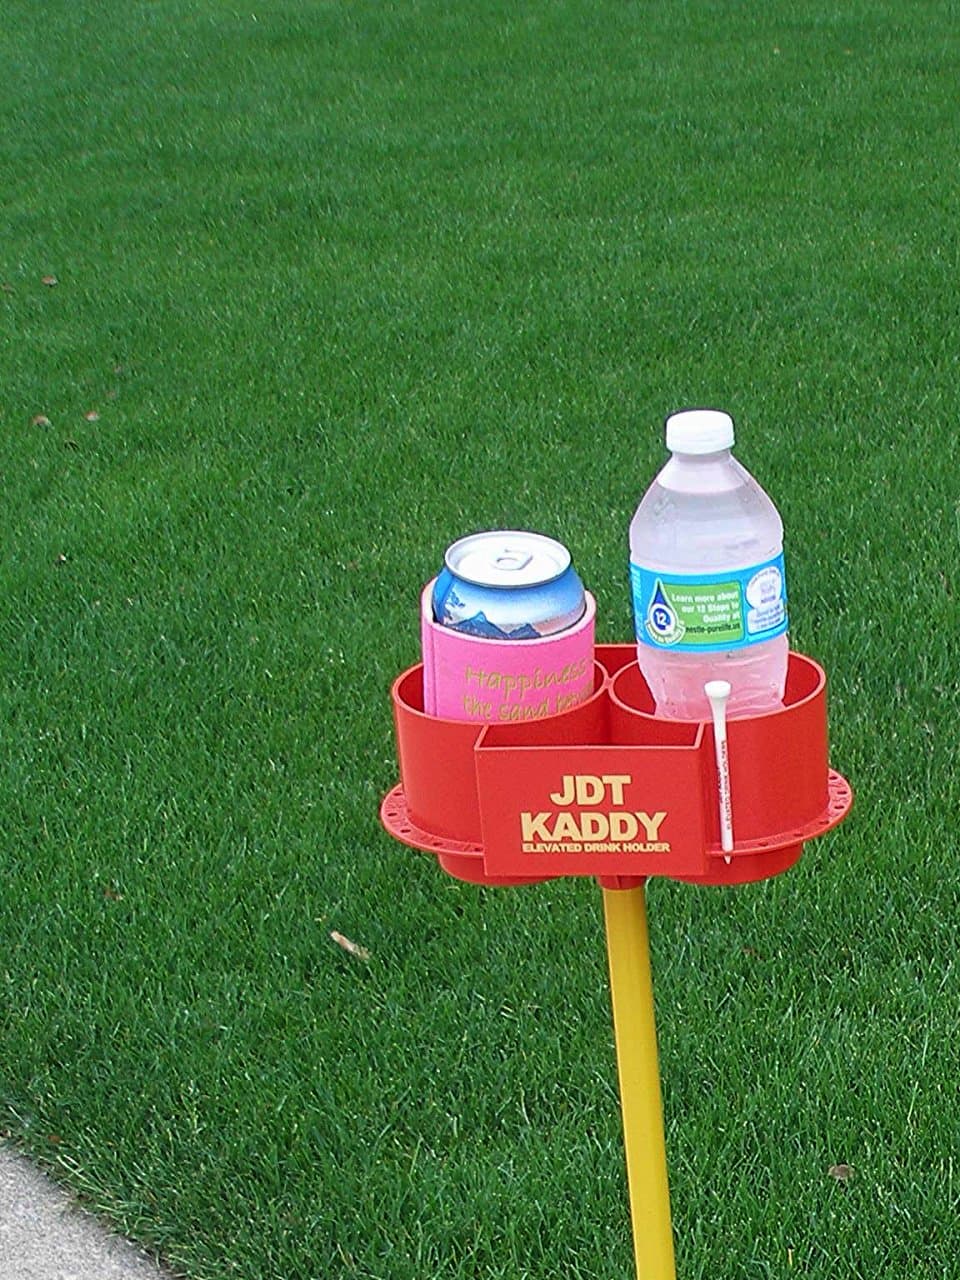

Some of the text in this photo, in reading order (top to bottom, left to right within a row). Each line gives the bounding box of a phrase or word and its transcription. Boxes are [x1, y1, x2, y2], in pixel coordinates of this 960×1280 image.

[671, 591, 739, 603] Learn more about
[655, 611, 667, 626] 12
[703, 613, 731, 624] Quality
[465, 659, 587, 700] Happiness
[463, 694, 492, 720] the
[498, 696, 550, 721] sand
[550, 775, 632, 806] JDT
[520, 812, 668, 842] KADDY
[522, 842, 671, 853] ELEVATED DRINK HOLDER
